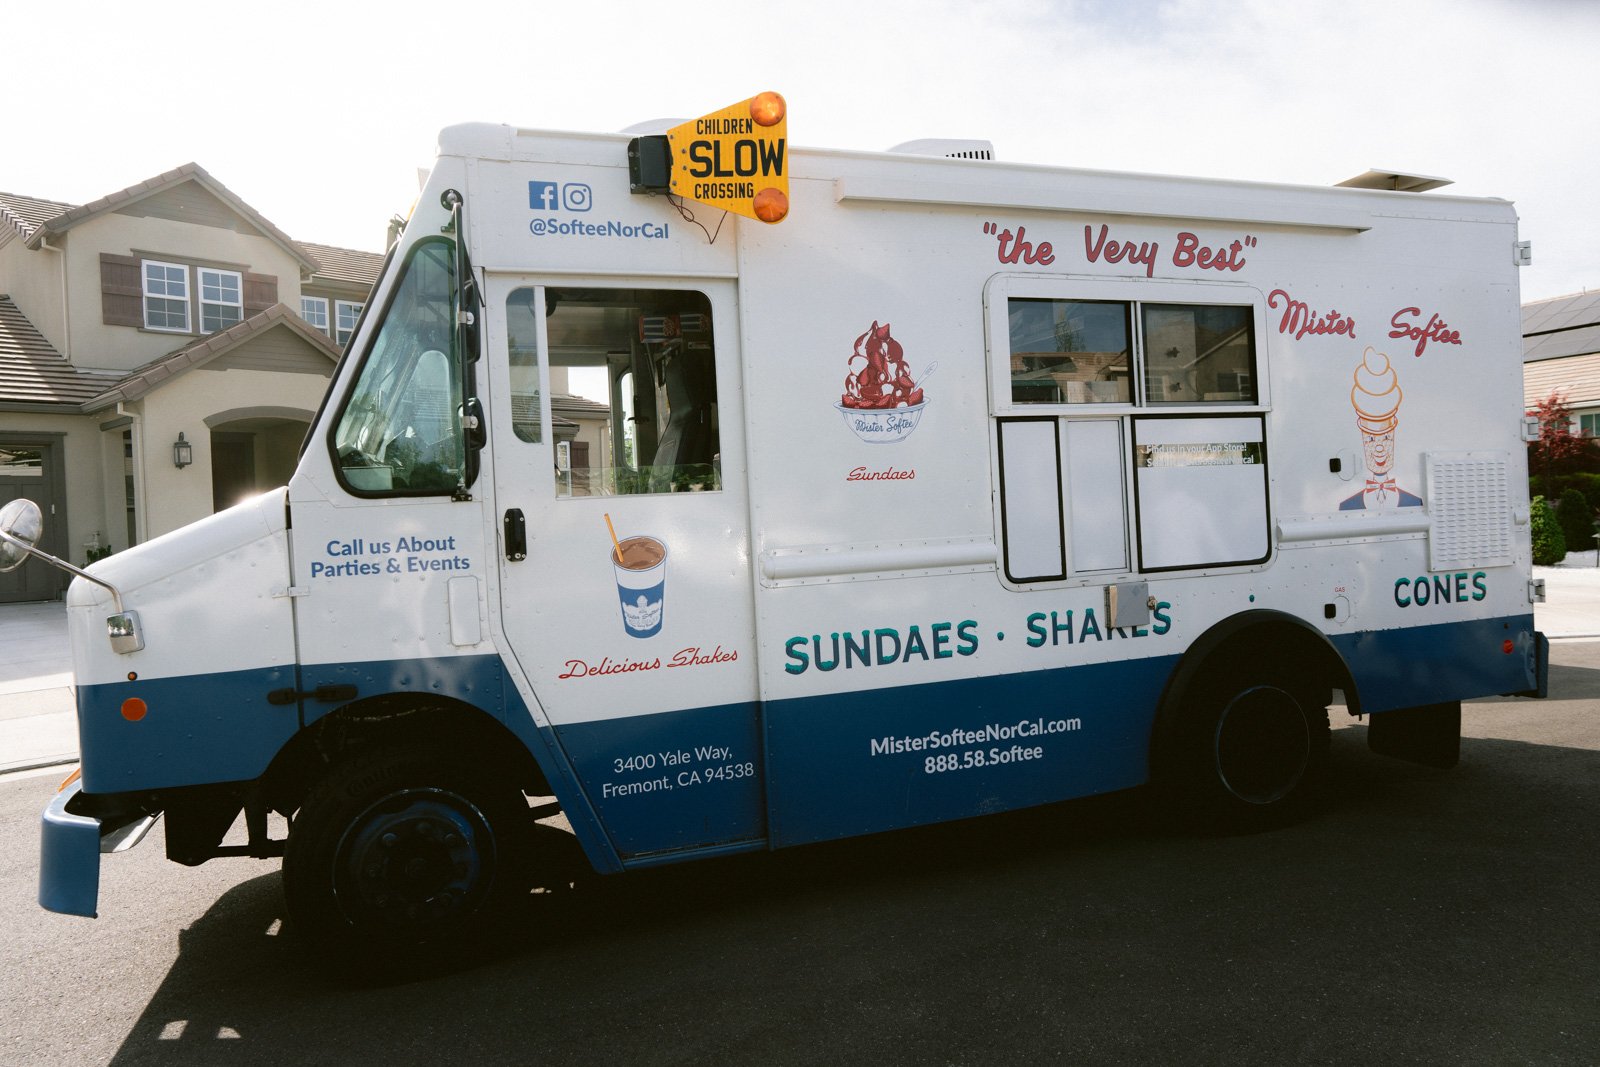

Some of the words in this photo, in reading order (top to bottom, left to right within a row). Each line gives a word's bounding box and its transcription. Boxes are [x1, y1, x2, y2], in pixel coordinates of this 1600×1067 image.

[696, 118, 753, 135] CHILDREN
[689, 138, 785, 178] SLOW
[694, 182, 754, 199] CROSSING
[530, 218, 669, 239] @SofteeNorCal
[983, 221, 1056, 266] "the
[1084, 223, 1159, 278] Very
[1172, 232, 1257, 272] Best"
[1267, 289, 1356, 341] Mister
[1388, 306, 1462, 358] Softee
[855, 419, 884, 433] Mister
[886, 416, 914, 434] Softee
[846, 466, 916, 482] Sundaes
[326, 539, 364, 557] Call
[369, 541, 391, 555] us
[395, 536, 456, 553] About
[310, 559, 381, 578] Parties
[385, 557, 402, 574] &
[407, 555, 471, 573] Events
[784, 619, 979, 675] SUNDAES
[1394, 570, 1488, 608] CONES
[558, 657, 661, 680] Delicious
[666, 645, 739, 668] Shakes
[870, 717, 1082, 757] MisterSofteeNorCal.com
[613, 754, 656, 773] 3400
[658, 749, 691, 767] Yale
[694, 745, 733, 762] Way,
[924, 744, 1043, 774] 888.58.Softee
[602, 776, 673, 799] Fremont,
[677, 770, 702, 787] CA
[704, 762, 754, 783] 94538
